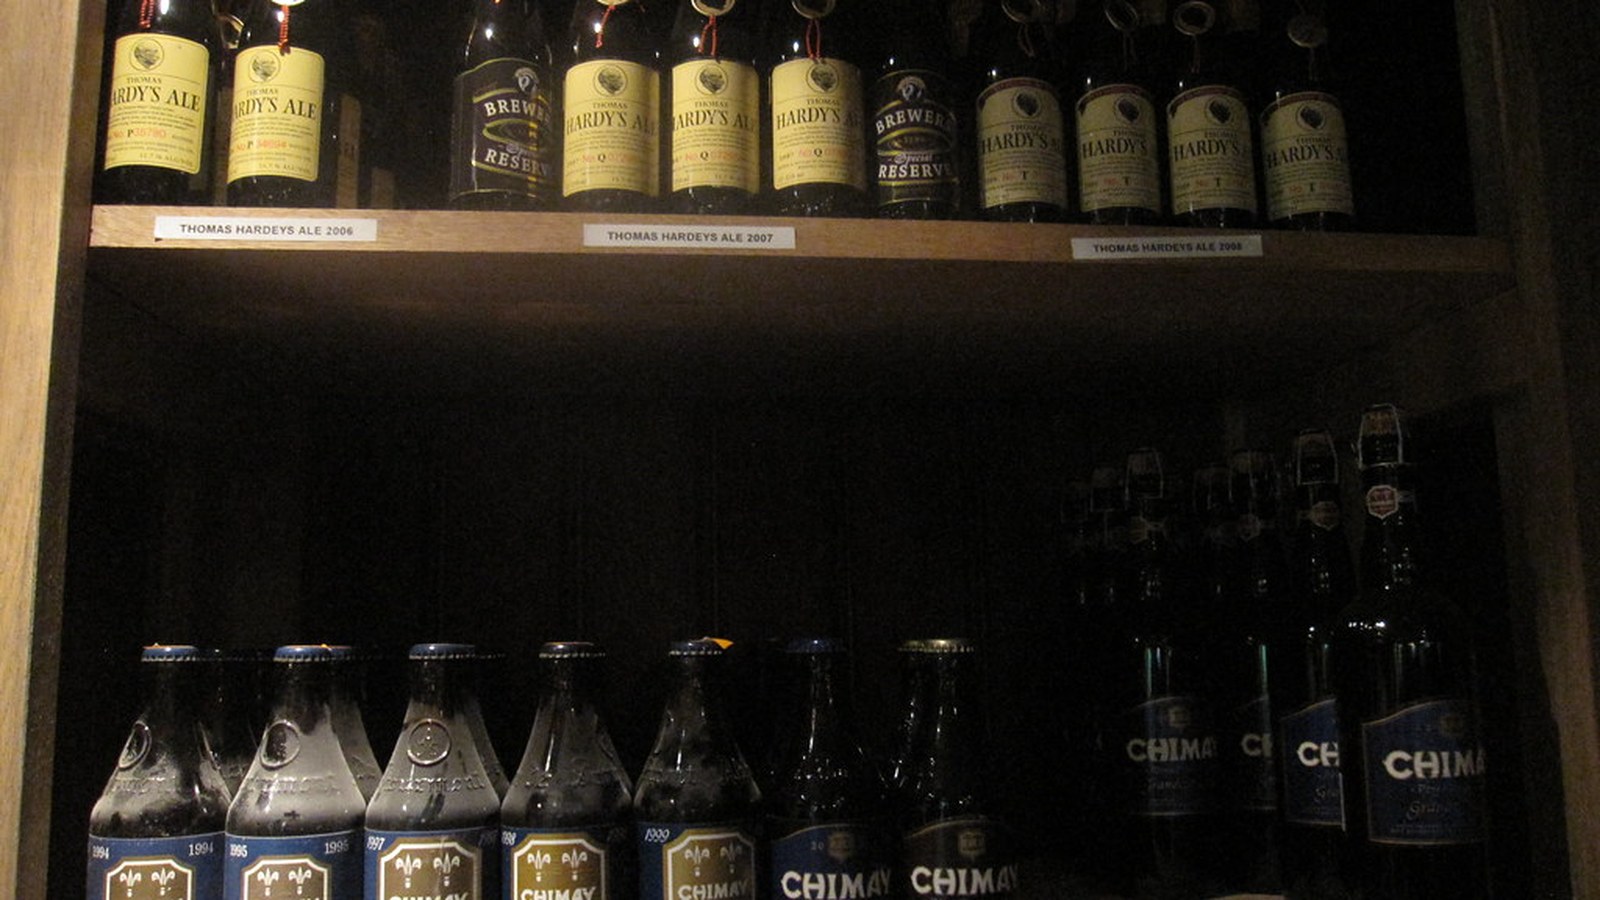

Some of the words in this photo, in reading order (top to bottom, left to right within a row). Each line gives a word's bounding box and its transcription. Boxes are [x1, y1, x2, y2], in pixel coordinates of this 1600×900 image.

[113, 85, 161, 106] ARDY'S
[165, 89, 200, 112] ALE
[235, 98, 278, 118] ARDY'S
[283, 99, 317, 119] ALE
[566, 111, 628, 135] HARDY'S
[674, 109, 728, 130] ARDY'S
[777, 106, 841, 130] HARDY'S
[982, 132, 1048, 154] HARDY'S
[1082, 138, 1148, 159] HARDY'S
[1174, 139, 1240, 162] HARDY'S
[1267, 144, 1334, 169] HARDY'S
[180, 224, 232, 234] THOMAS
[236, 225, 295, 236] HARDEYS
[299, 226, 322, 236] ALE
[326, 226, 354, 236] 2006
[608, 231, 658, 241] THOMAS
[662, 232, 718, 242] HARDEYS
[721, 233, 744, 243] ALE
[747, 234, 774, 243] 2007
[1093, 244, 1138, 254] THOMAS
[1142, 243, 1193, 252] HARDEYS
[1196, 243, 1215, 251] ALE
[644, 828, 670, 843] 1999
[187, 842, 214, 857] 1994
[324, 839, 350, 855] 1995
[781, 866, 891, 900] CHIMAY
[909, 862, 1019, 896] CHIMAY
[678, 881, 748, 900] CHIMAY
